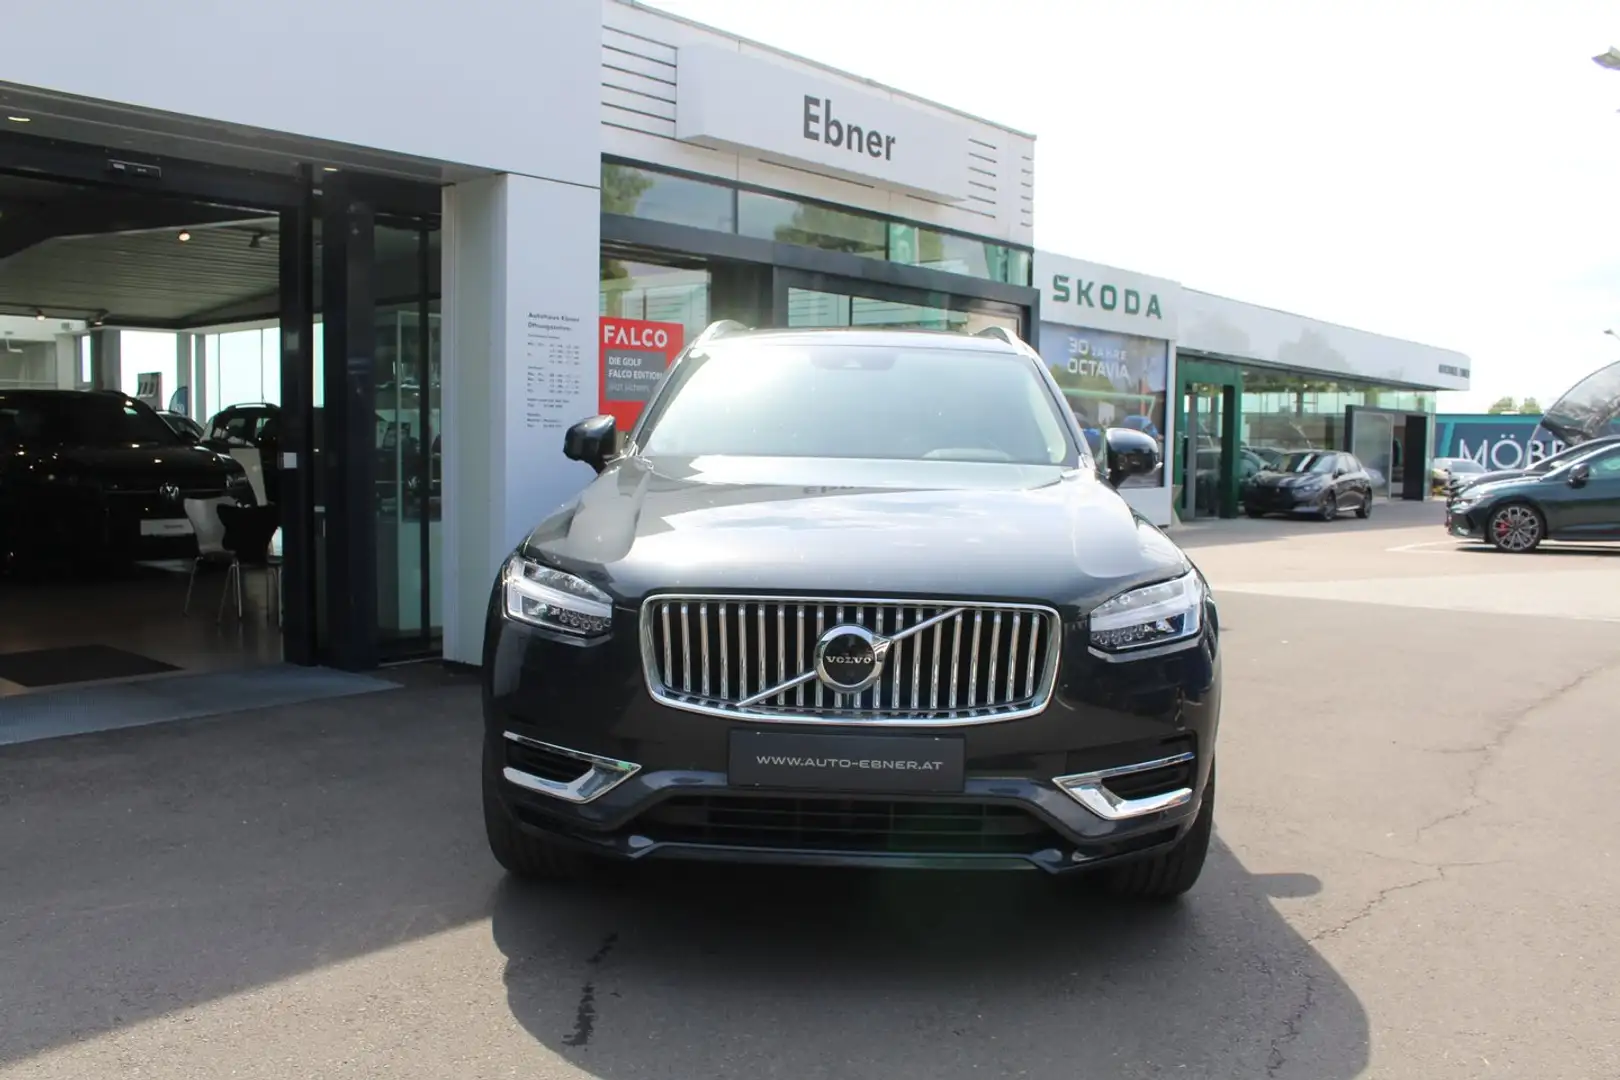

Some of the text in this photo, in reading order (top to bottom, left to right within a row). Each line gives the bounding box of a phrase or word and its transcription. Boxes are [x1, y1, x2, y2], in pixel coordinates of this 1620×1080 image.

[803, 94, 896, 161] Ebner
[1053, 274, 1162, 319] SKODA
[604, 325, 668, 348] FALCO
[1068, 336, 1089, 356] 30
[608, 356, 642, 367] DIE GOLF
[1067, 358, 1130, 380] OCTAVIA
[608, 369, 632, 379] FALCO
[826, 655, 872, 665] VOLVO
[756, 755, 944, 771] WWW.AUTO-EBNER.AT
